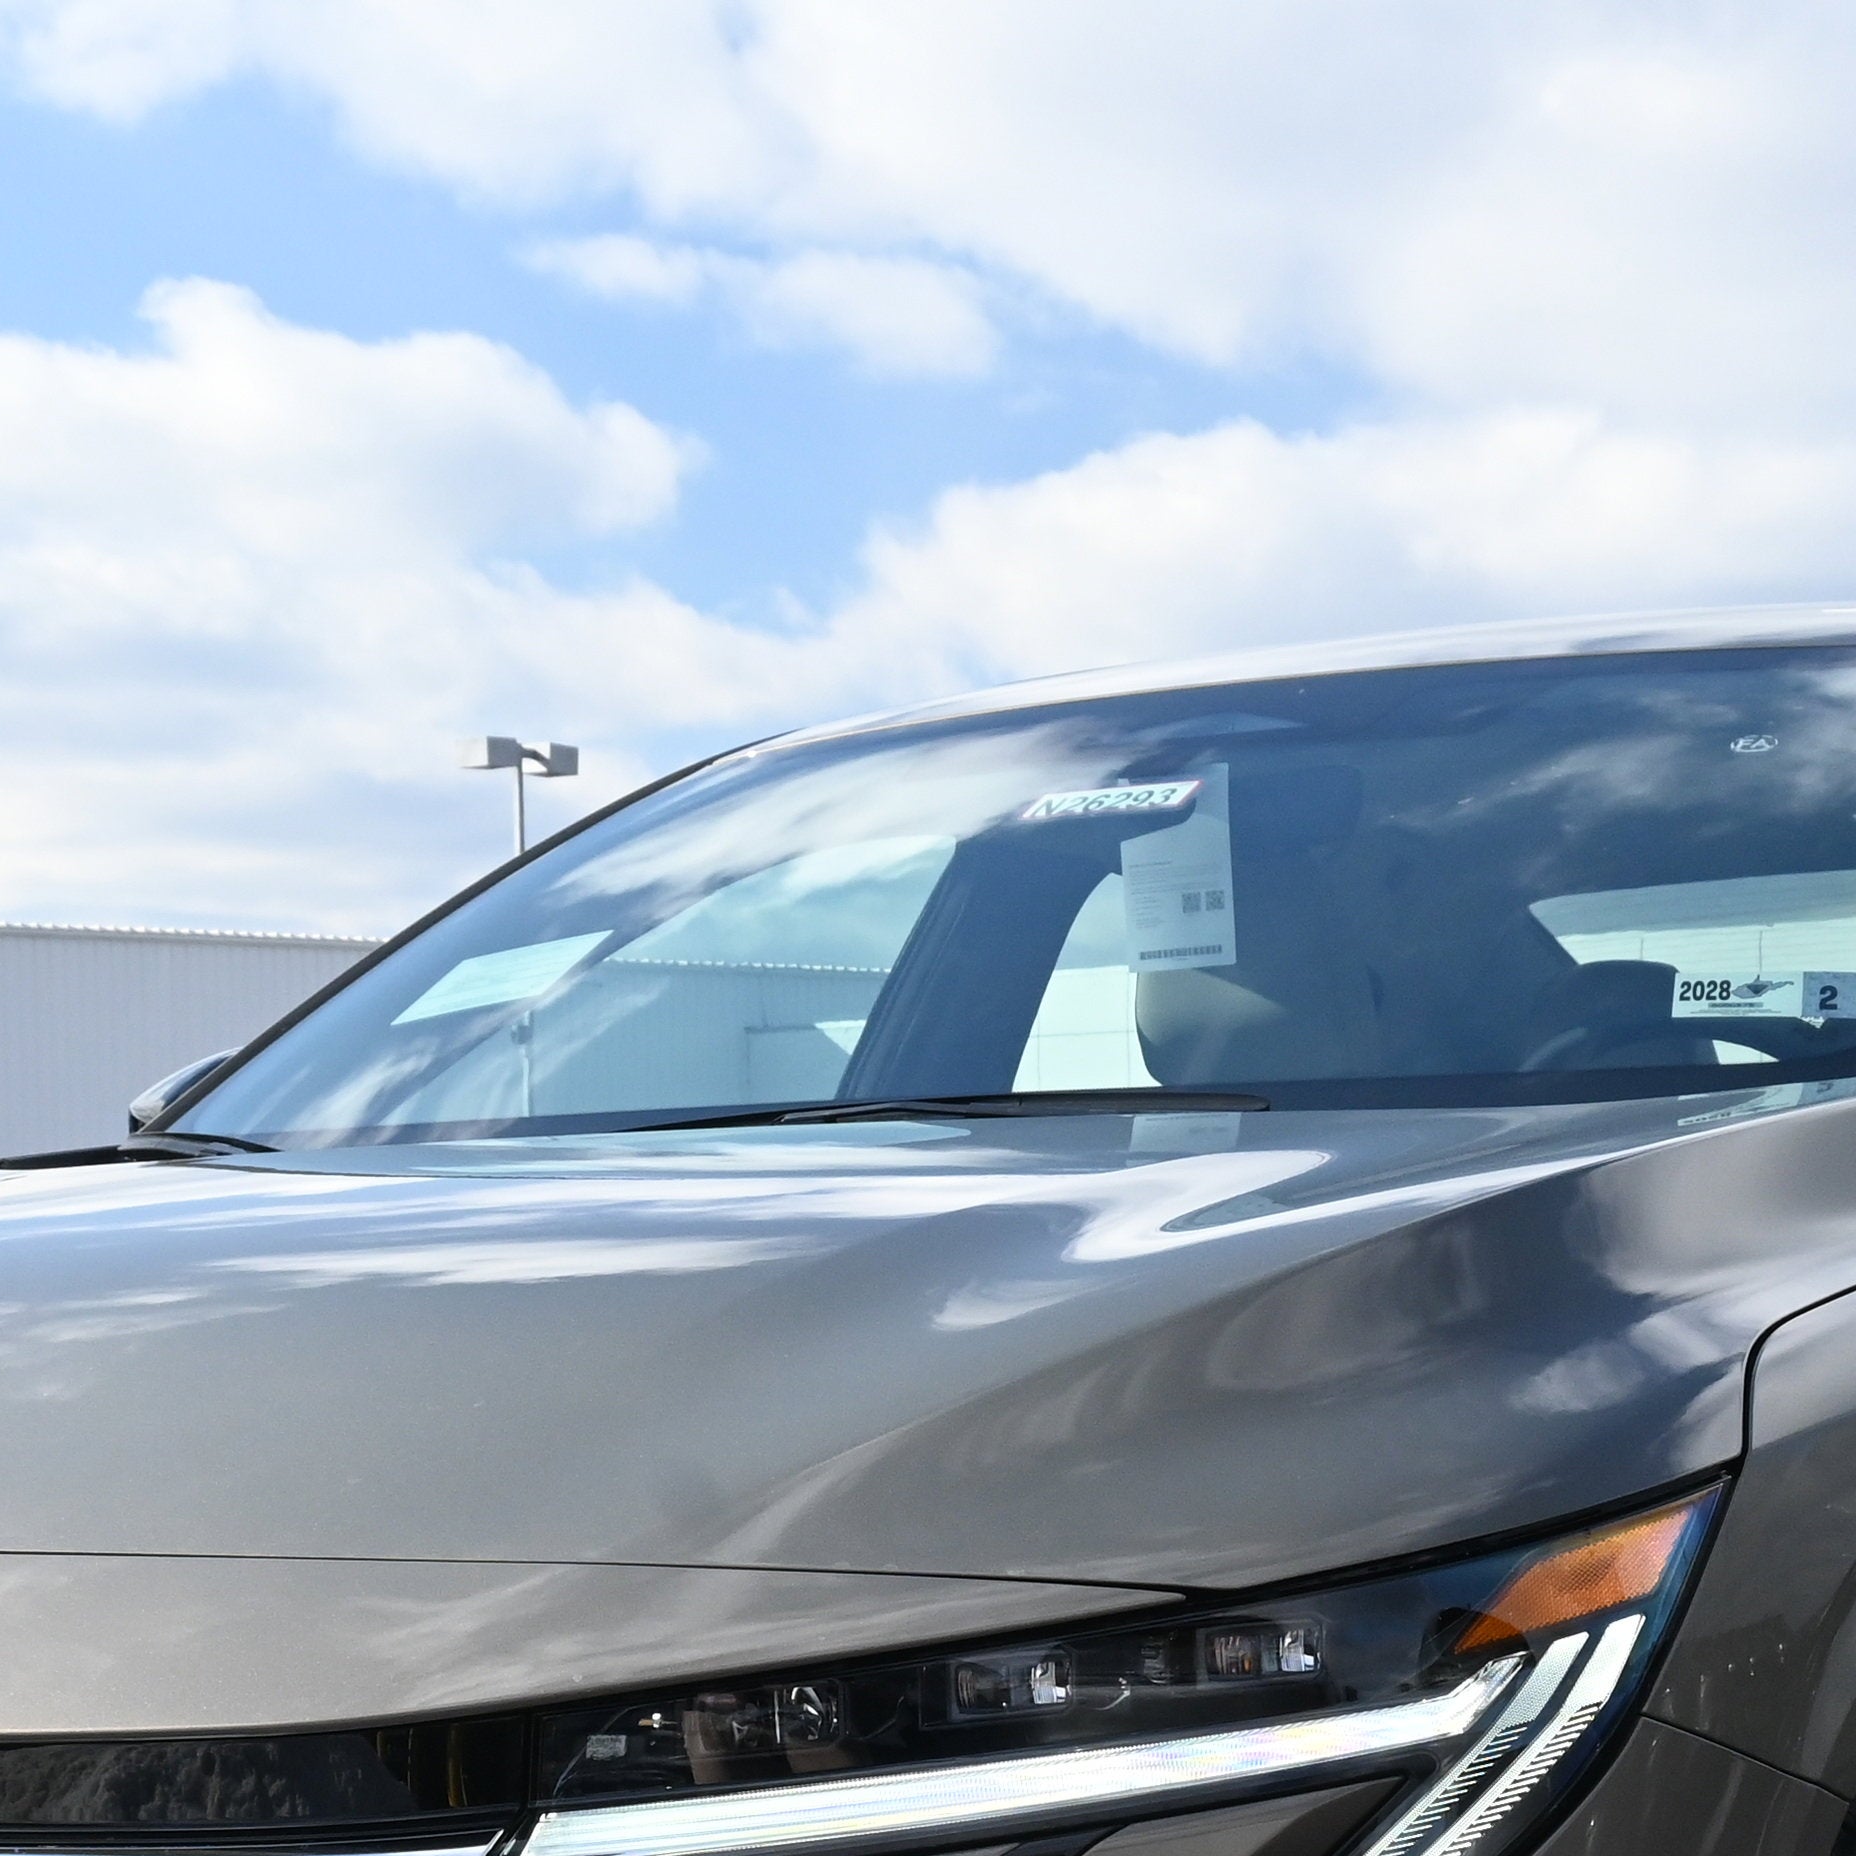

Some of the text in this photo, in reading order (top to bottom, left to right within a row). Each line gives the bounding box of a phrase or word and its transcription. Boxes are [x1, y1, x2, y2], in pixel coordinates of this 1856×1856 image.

[1031, 787, 1178, 816] N26293
[1679, 980, 1731, 1001] 2028
[1818, 985, 1839, 1010] 2
